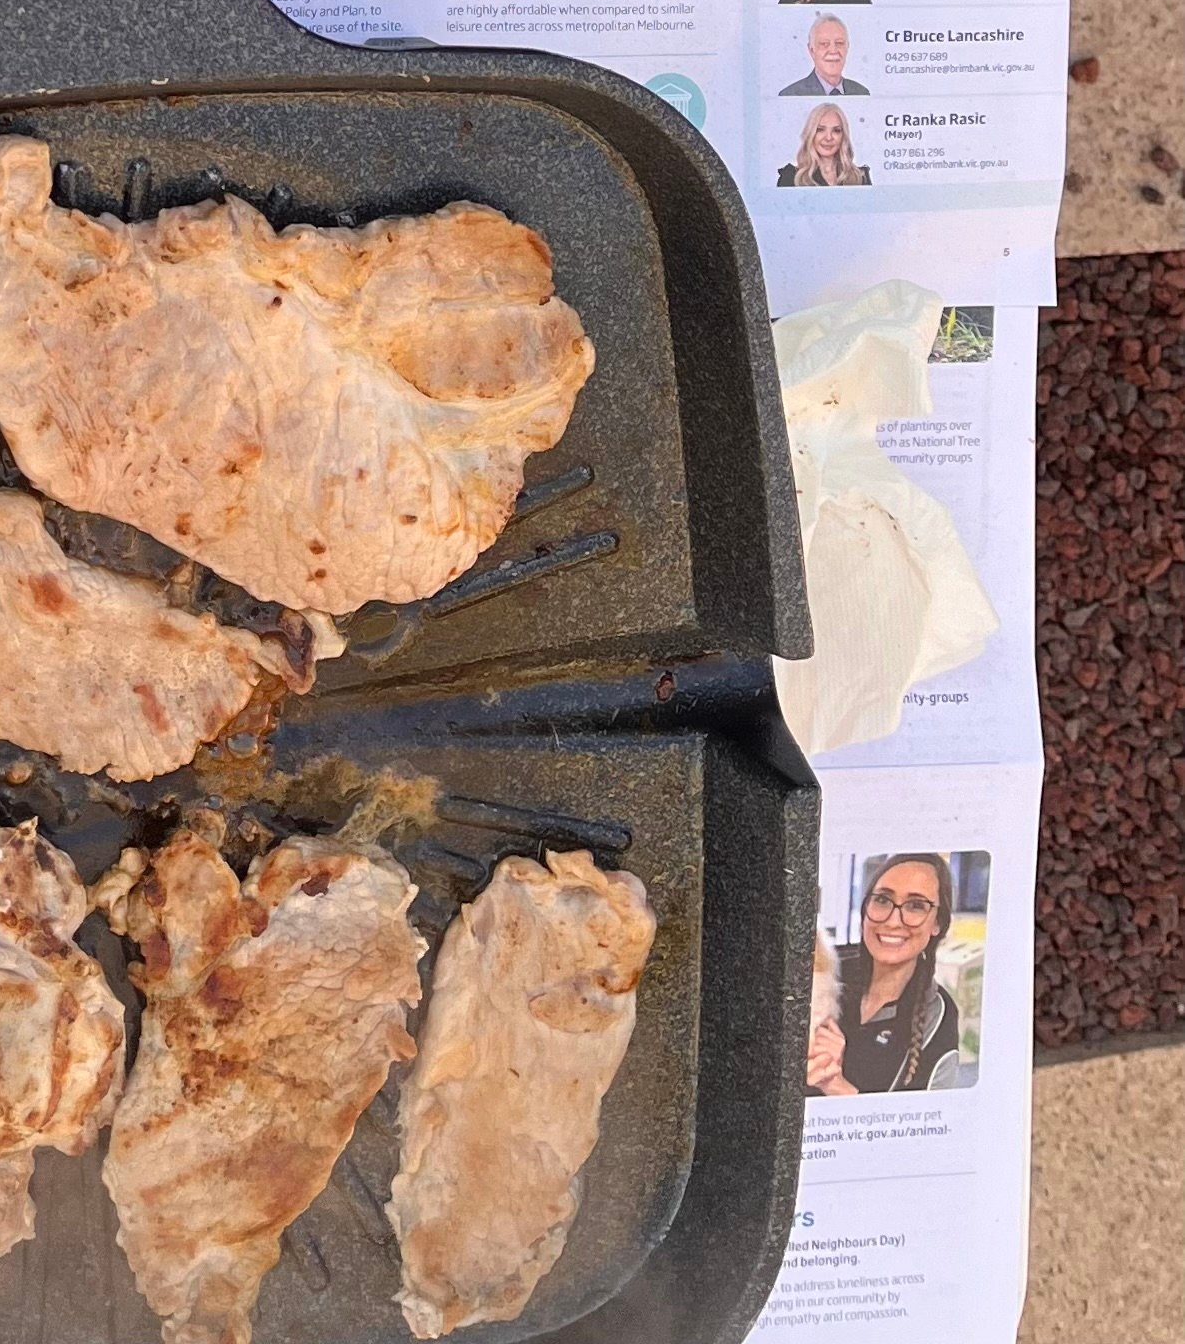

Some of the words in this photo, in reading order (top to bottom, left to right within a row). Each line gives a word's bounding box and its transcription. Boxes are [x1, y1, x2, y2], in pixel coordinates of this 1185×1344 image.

[885, 30, 900, 42] Cr
[903, 30, 944, 42] Bruce
[948, 29, 1023, 41] Lancashire
[884, 114, 899, 126] Cr
[902, 113, 945, 126] Ranka
[949, 112, 985, 124] Rasic
[884, 130, 922, 140] (Mayor)
[1002, 246, 1011, 258] 5
[811, 1237, 877, 1251] Neighbours
[879, 1234, 905, 1246] Day)
[800, 1254, 860, 1267] belonging.
